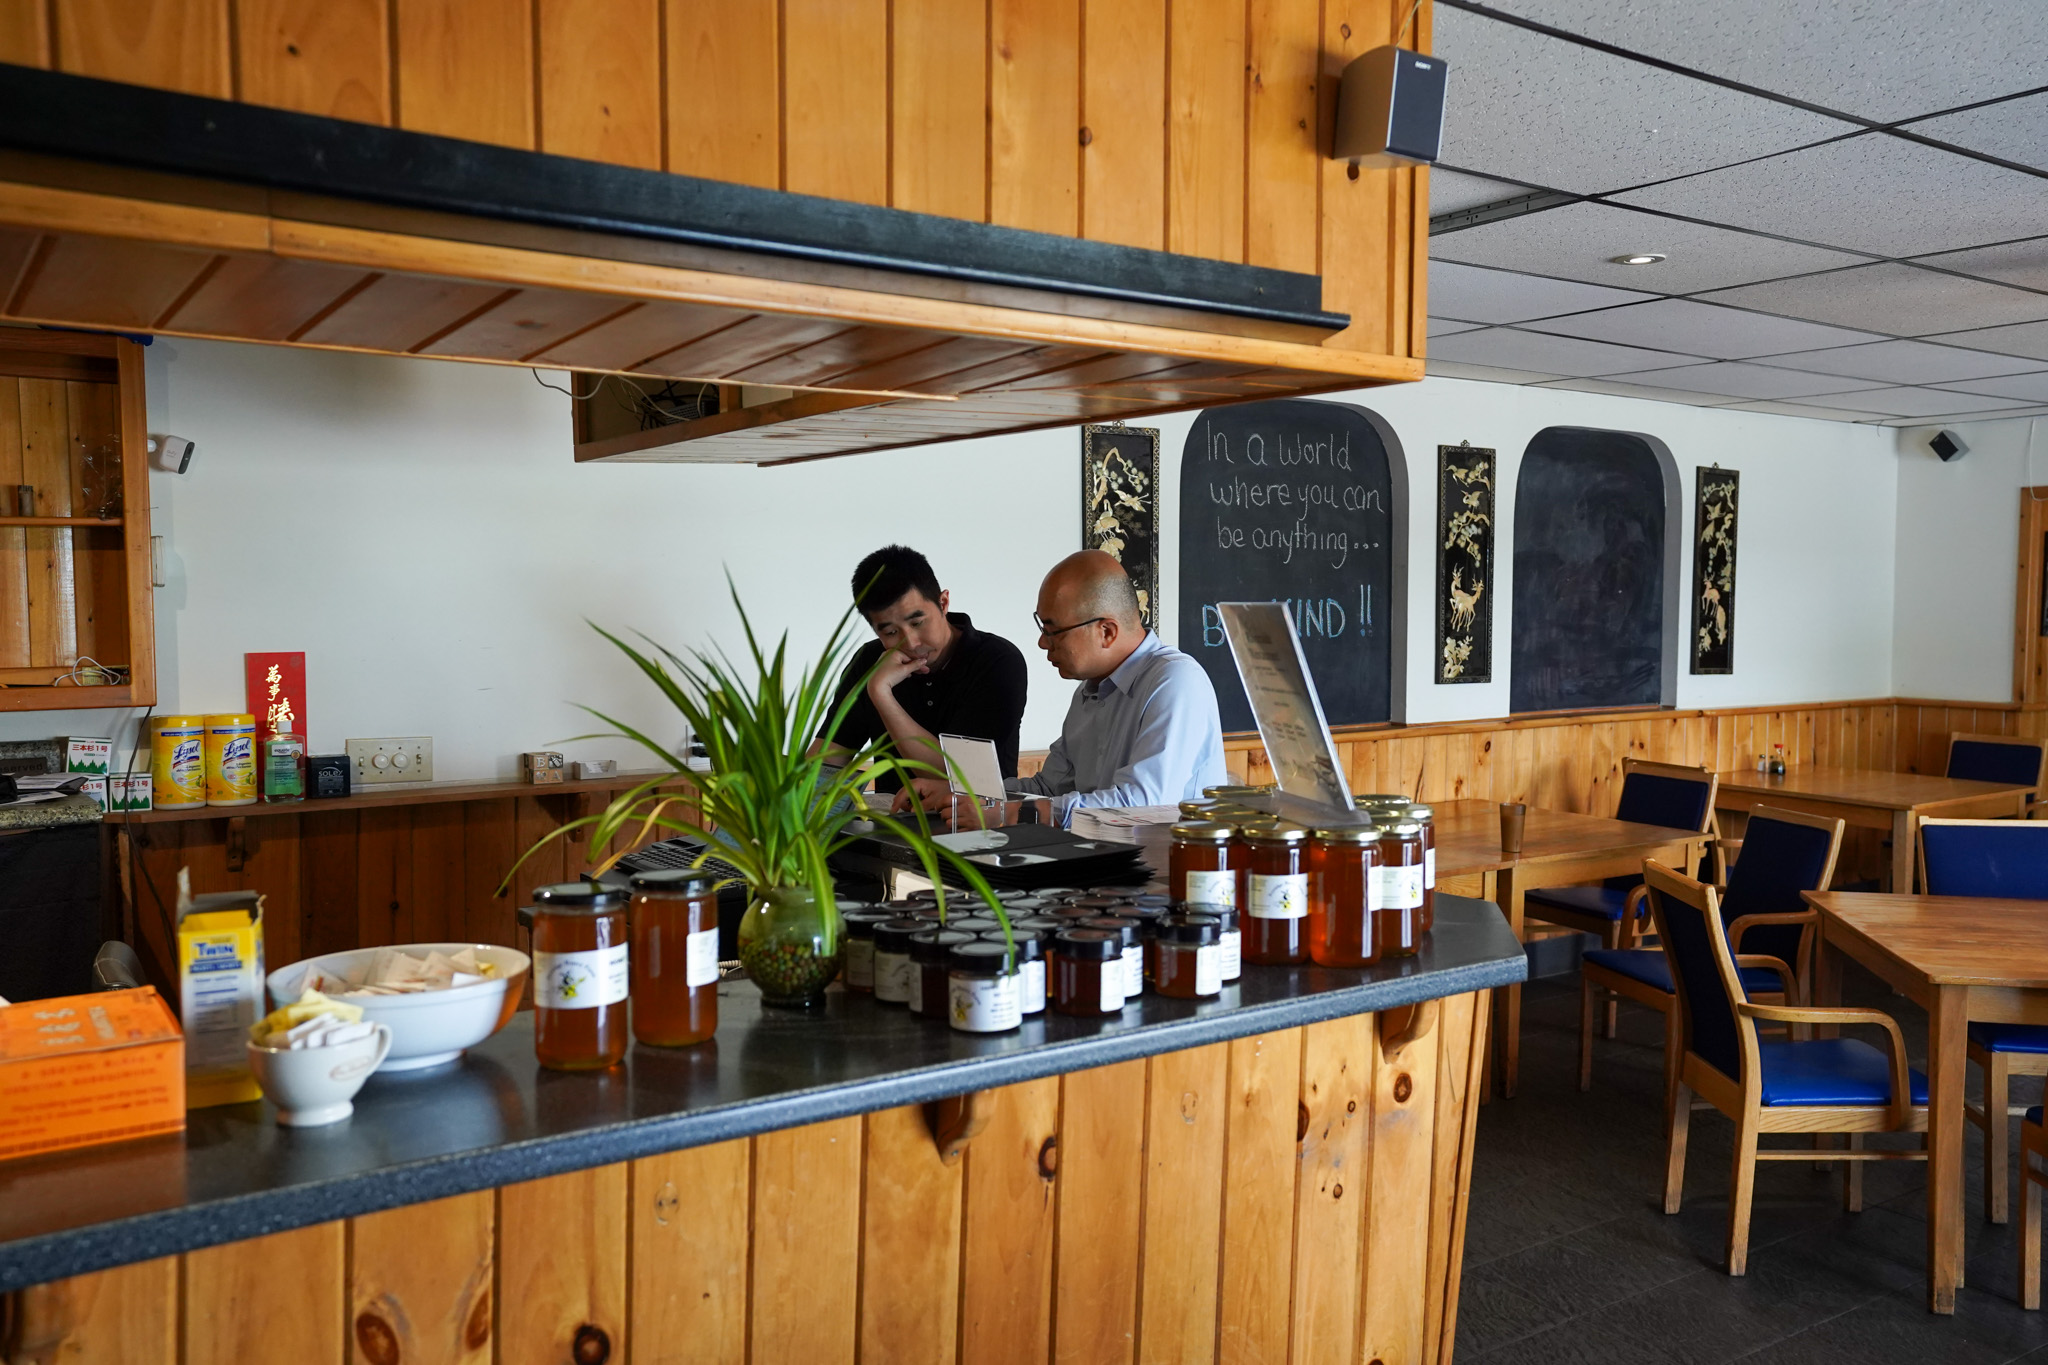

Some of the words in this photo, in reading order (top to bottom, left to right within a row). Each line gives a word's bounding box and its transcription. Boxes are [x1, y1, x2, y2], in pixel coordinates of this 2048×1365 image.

[1207, 420, 1234, 464] In
[1247, 433, 1268, 466] a
[1210, 475, 1293, 508] where
[1298, 484, 1339, 521] you
[1343, 485, 1385, 514] can
[1217, 516, 1247, 549] be
[1271, 597, 1346, 638] IND
[173, 742, 200, 760] Lysol
[223, 739, 250, 757] Lysol
